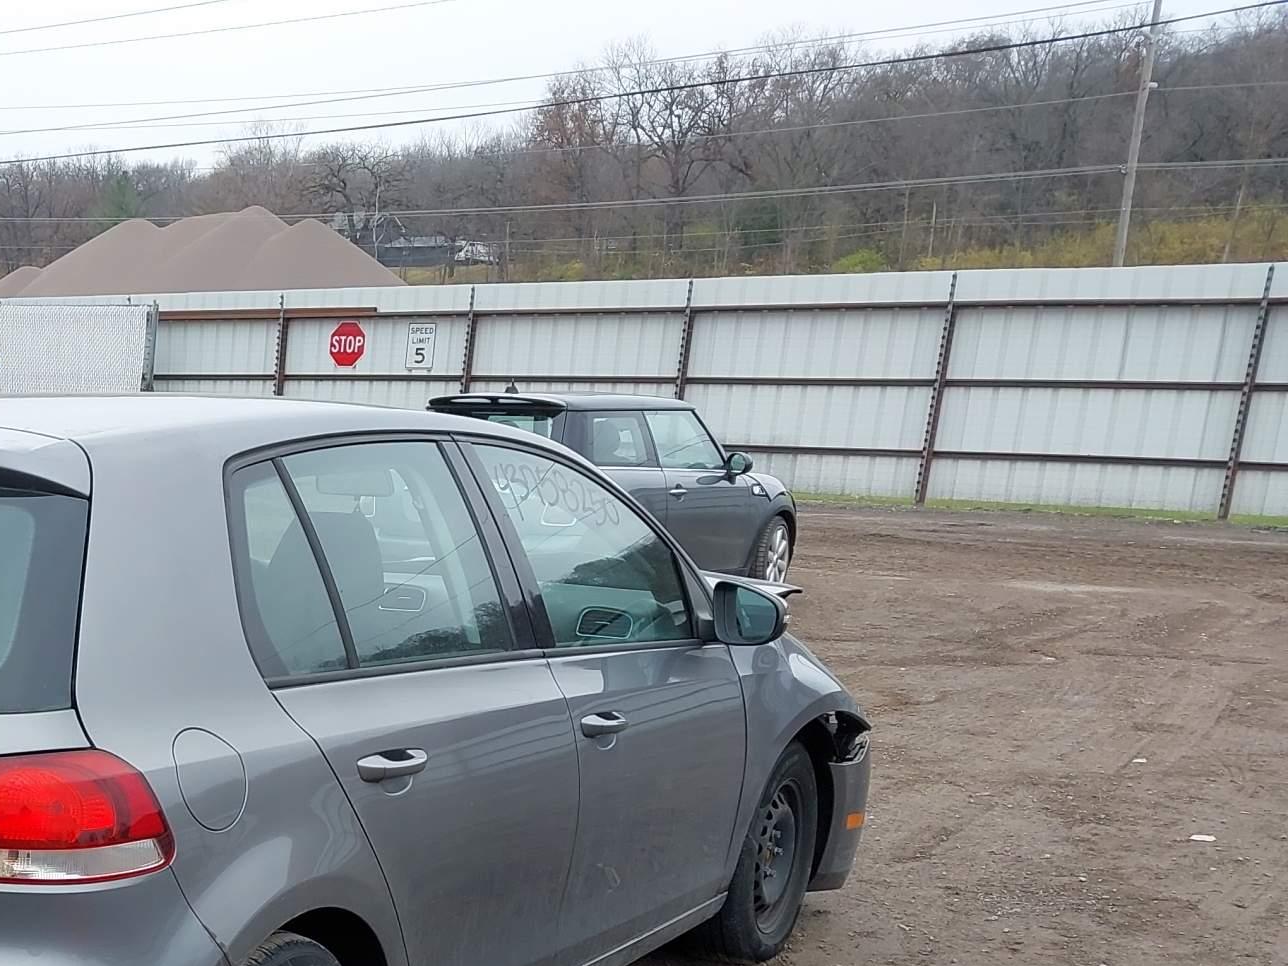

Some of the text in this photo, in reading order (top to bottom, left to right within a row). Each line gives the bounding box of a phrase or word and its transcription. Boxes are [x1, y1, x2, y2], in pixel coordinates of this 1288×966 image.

[410, 327, 434, 335] SPEED
[331, 335, 364, 353] STOP
[411, 337, 431, 345] LIMIT
[414, 347, 426, 364] 5
